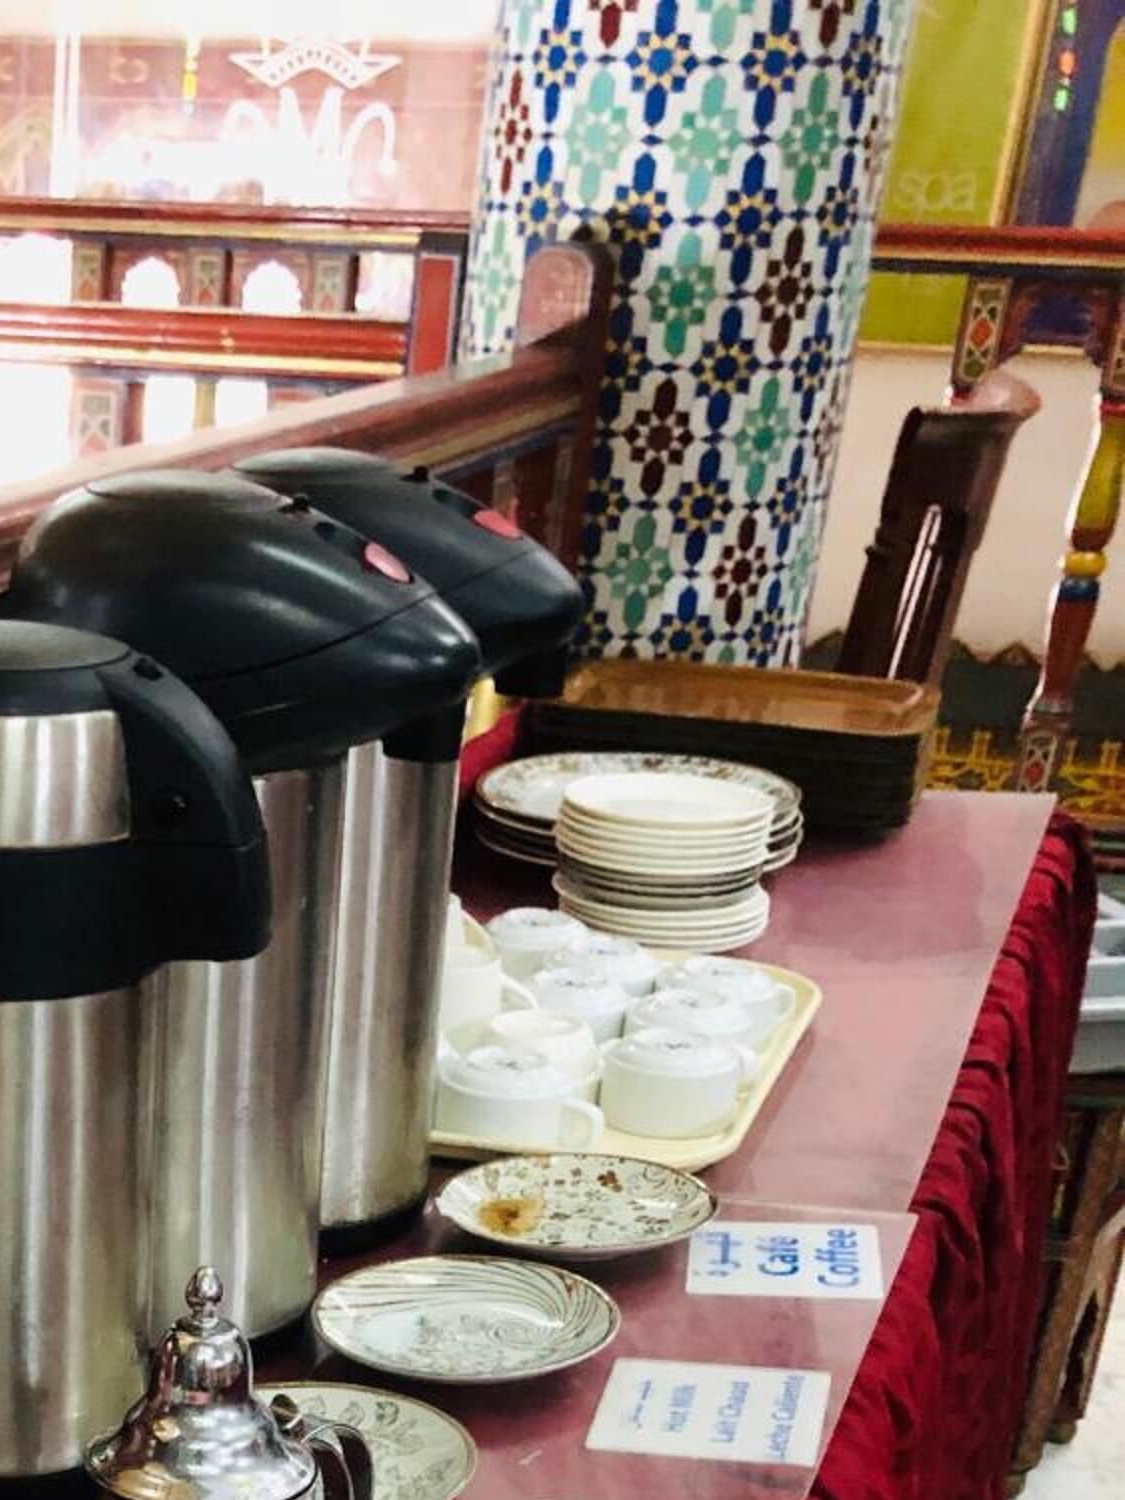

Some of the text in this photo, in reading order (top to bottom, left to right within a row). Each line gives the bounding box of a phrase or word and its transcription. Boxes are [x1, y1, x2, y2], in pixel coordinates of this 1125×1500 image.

[756, 1234, 800, 1276] Café
[815, 1229, 860, 1287] Coffee
[709, 1381, 752, 1443] Lait Chaud
